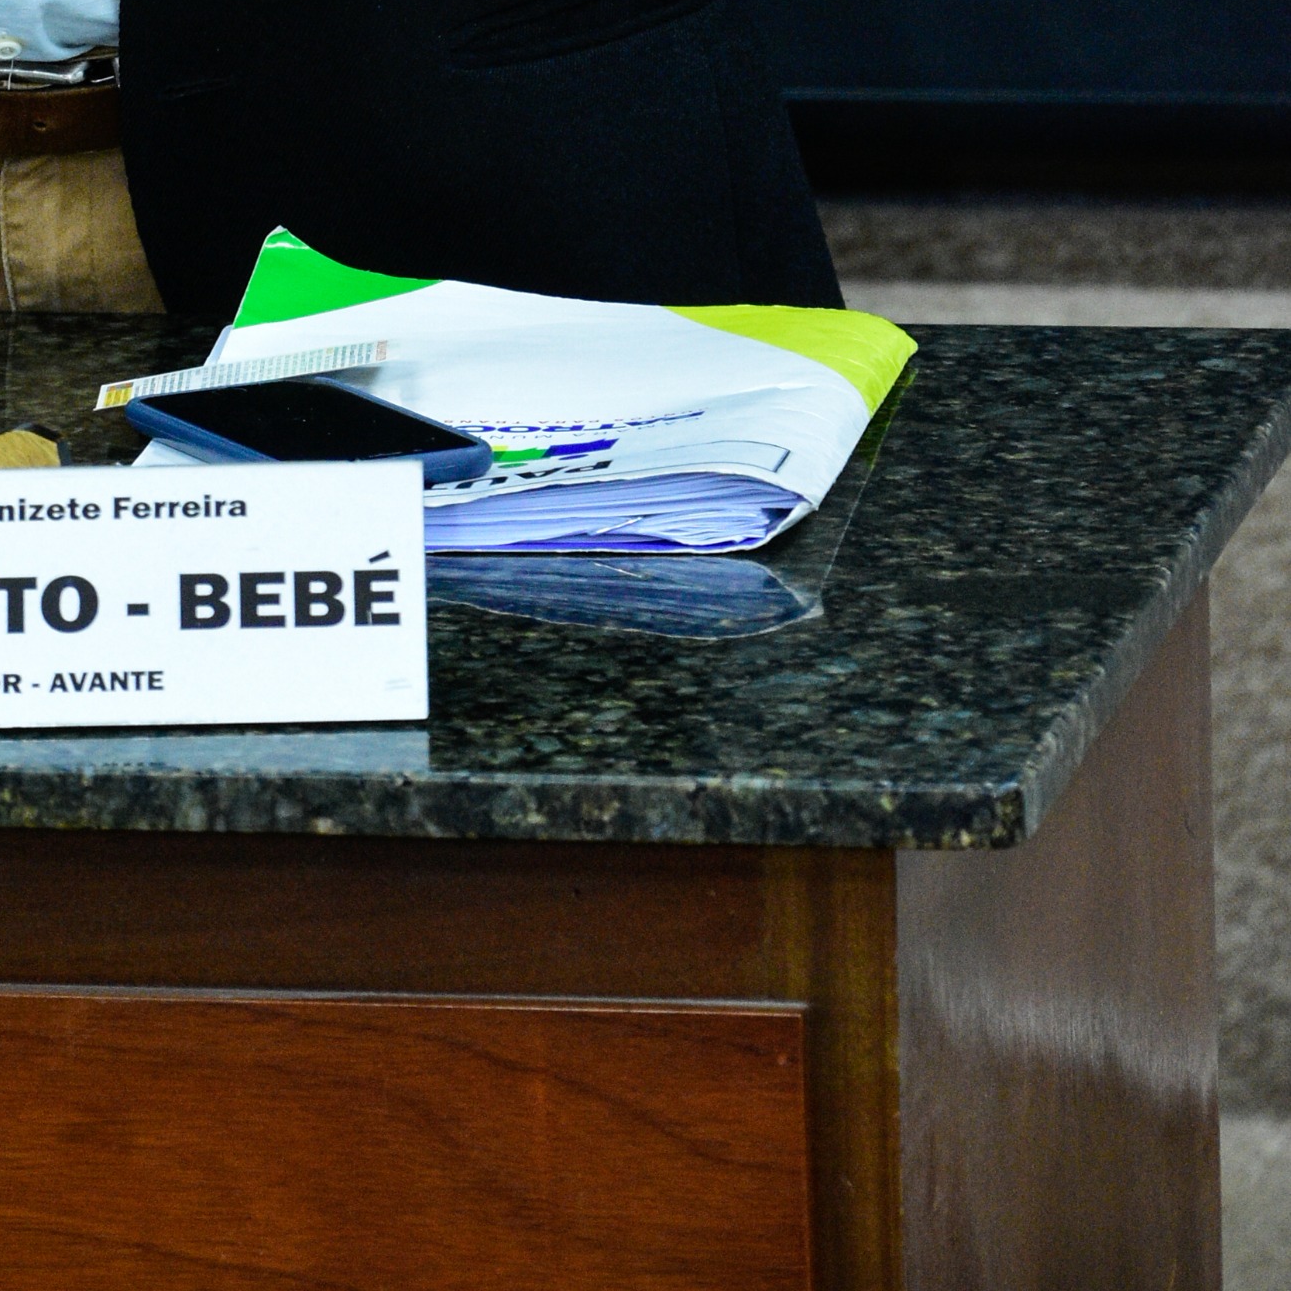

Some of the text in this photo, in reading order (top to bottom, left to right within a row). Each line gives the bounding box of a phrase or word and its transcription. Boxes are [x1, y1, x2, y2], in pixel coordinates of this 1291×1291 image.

[454, 410, 706, 433] PATROC
[113, 494, 246, 519] Ferreira
[127, 603, 149, 616] -
[179, 550, 400, 630] BEBÉ
[50, 670, 163, 692] AVANTE
